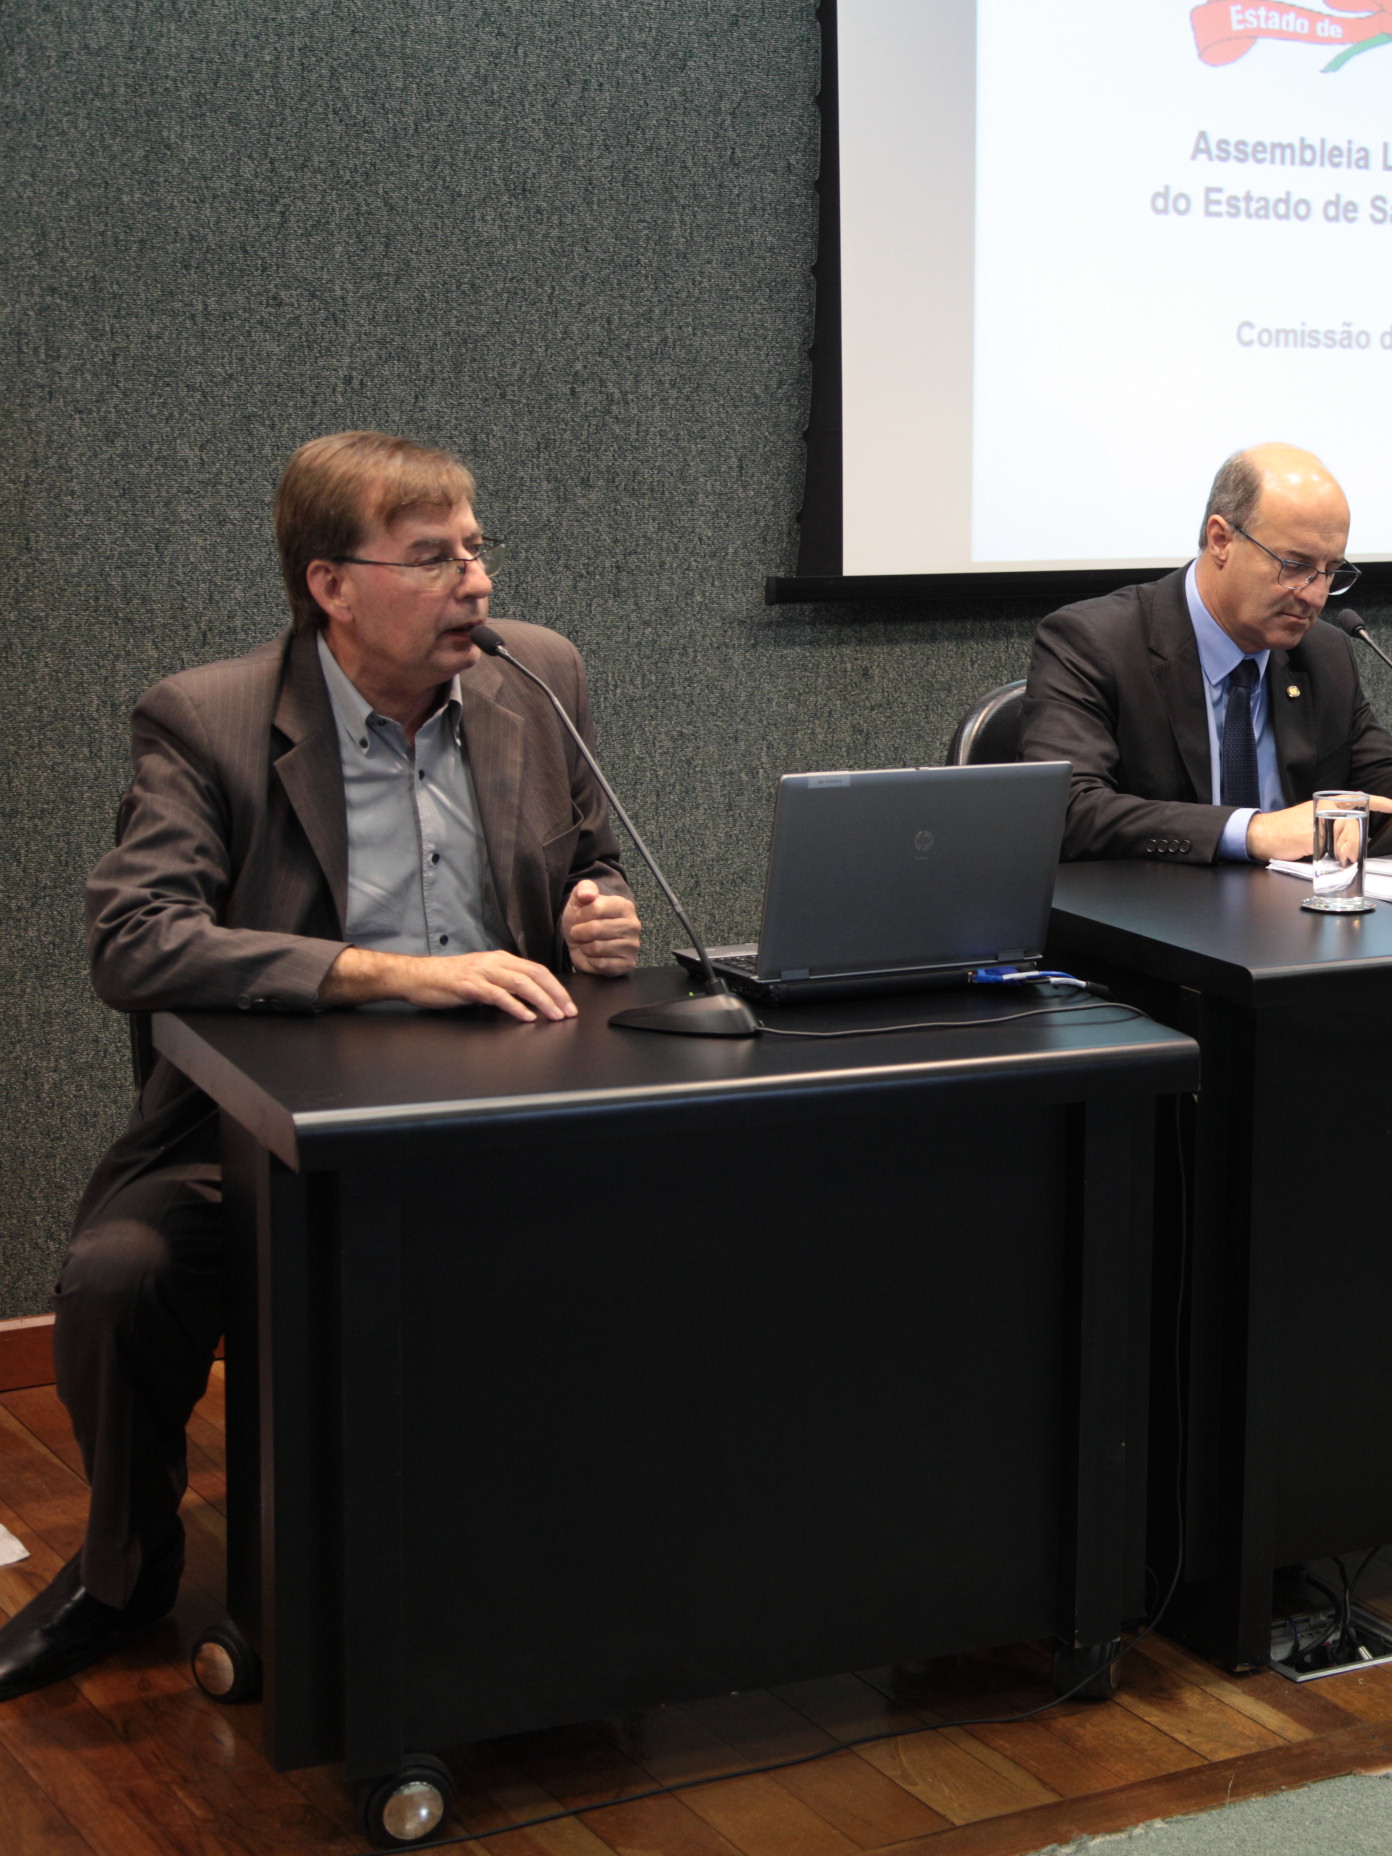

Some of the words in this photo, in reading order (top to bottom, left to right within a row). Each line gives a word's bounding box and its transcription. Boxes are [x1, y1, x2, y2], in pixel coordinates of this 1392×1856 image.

[1229, 4, 1309, 34] Estado
[1315, 18, 1343, 38] de
[1190, 130, 1371, 171] Assembleia
[1150, 184, 1192, 216] do
[1203, 186, 1312, 221] Estado
[1322, 193, 1360, 224] de
[1235, 320, 1372, 351] Comissão
